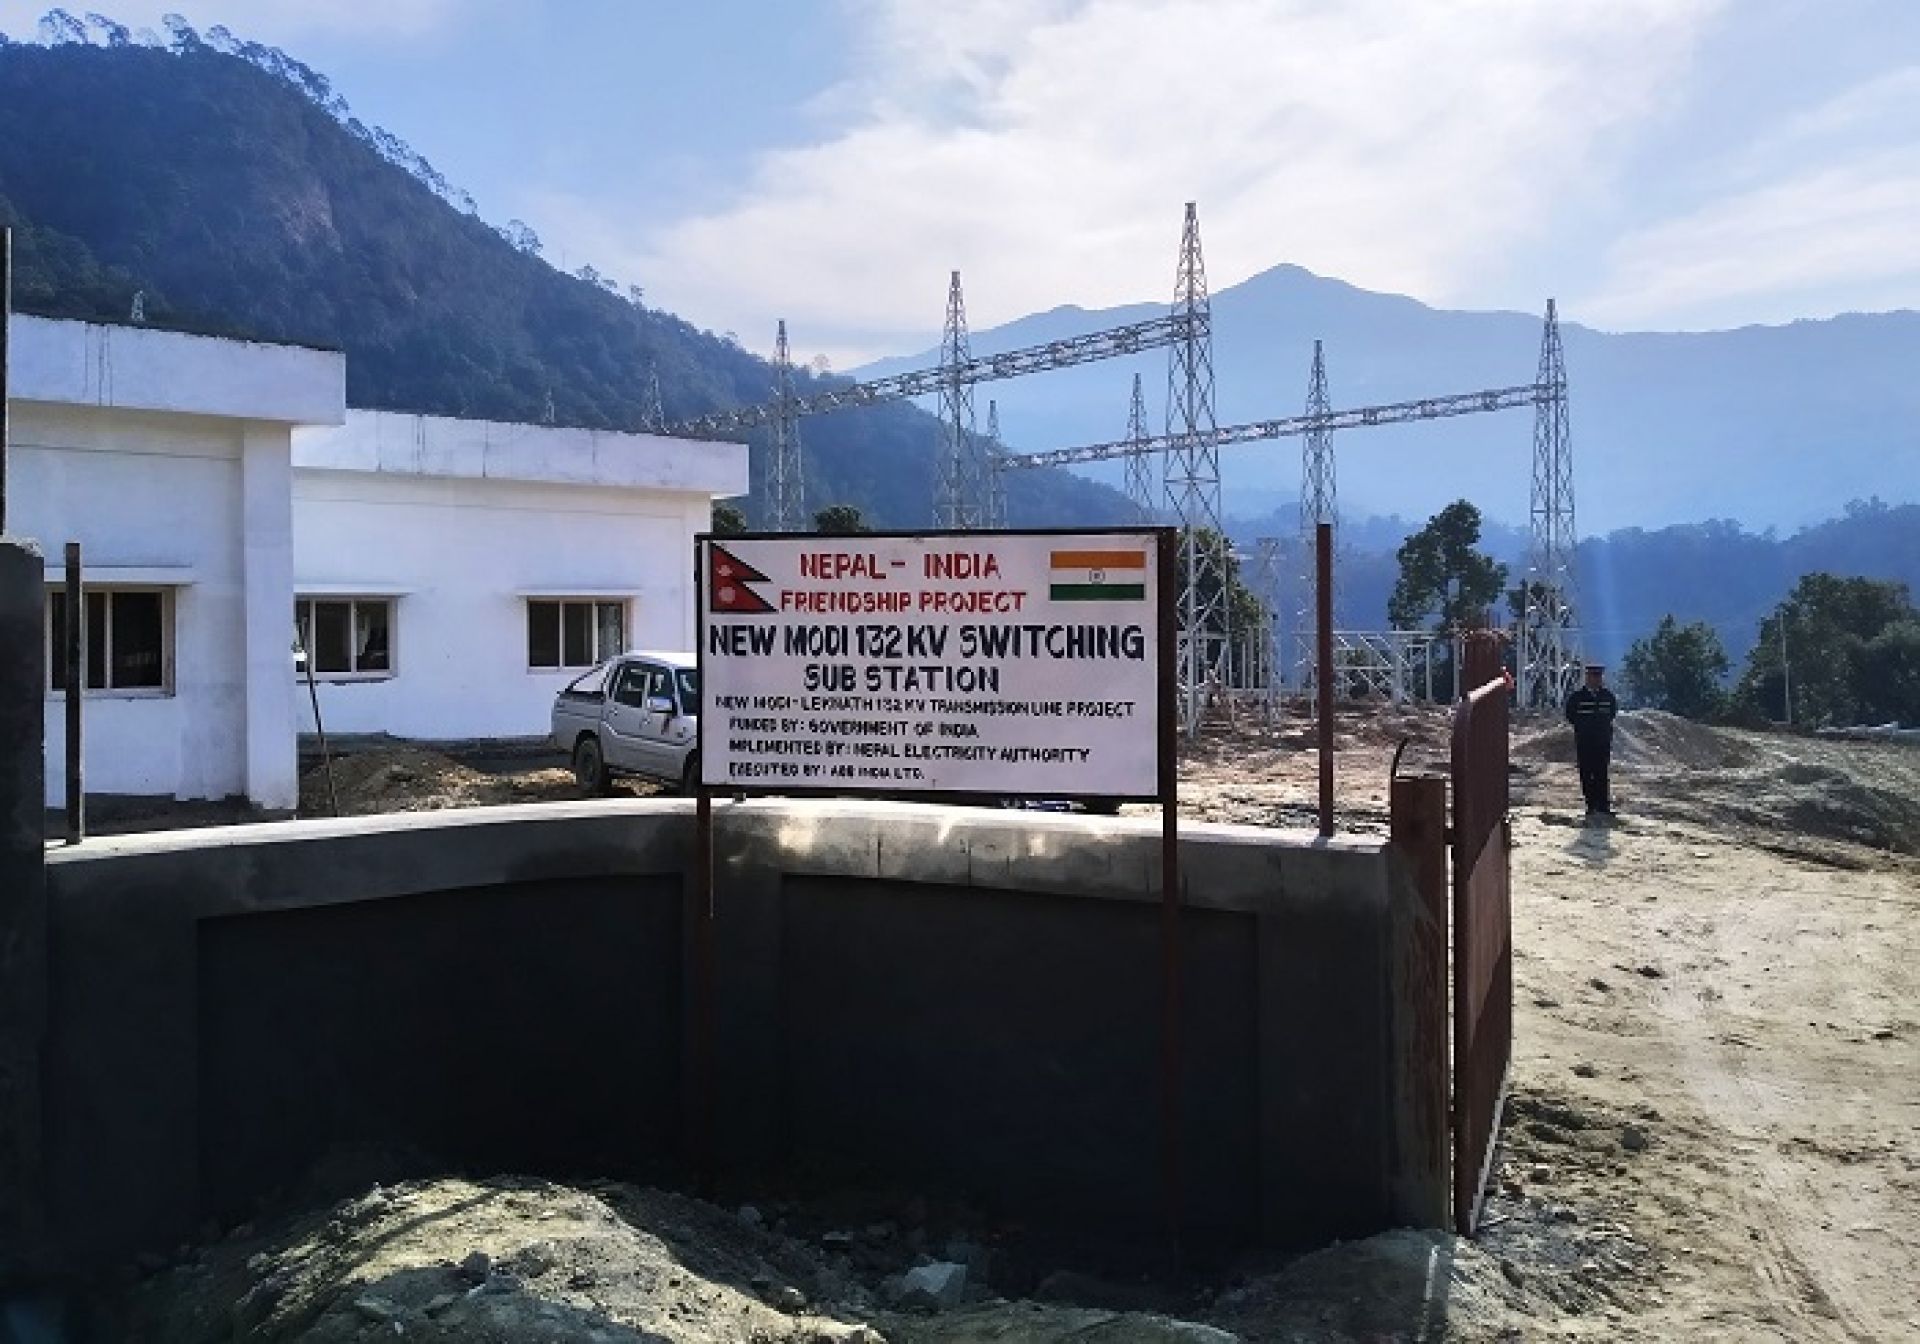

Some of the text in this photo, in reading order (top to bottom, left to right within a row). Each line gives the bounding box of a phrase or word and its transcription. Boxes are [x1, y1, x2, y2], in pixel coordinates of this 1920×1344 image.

[801, 553, 887, 579] NEPAL
[923, 553, 1002, 580] INDIA
[780, 590, 1027, 613] FRIENDSHIP PROJECT
[709, 624, 1145, 660] NEW MODI 132 KV SWITCHING
[804, 664, 1000, 694] SUB STATION
[715, 695, 750, 710] NEW
[929, 699, 1029, 716] TRANSMISSION
[1031, 701, 1062, 717] LINE
[1066, 701, 1136, 718] PROJECT
[729, 717, 777, 732] FUNDED
[808, 719, 909, 735] GOVERNMENT
[913, 721, 933, 738] OF
[729, 739, 823, 755] IMPLEMENTED
[852, 742, 901, 758] NEPAL
[904, 742, 998, 760] ELECTRICITY
[1000, 747, 1090, 763] AUTHORITY
[729, 761, 799, 777] EXECUTED
[857, 767, 890, 779] INDIA
